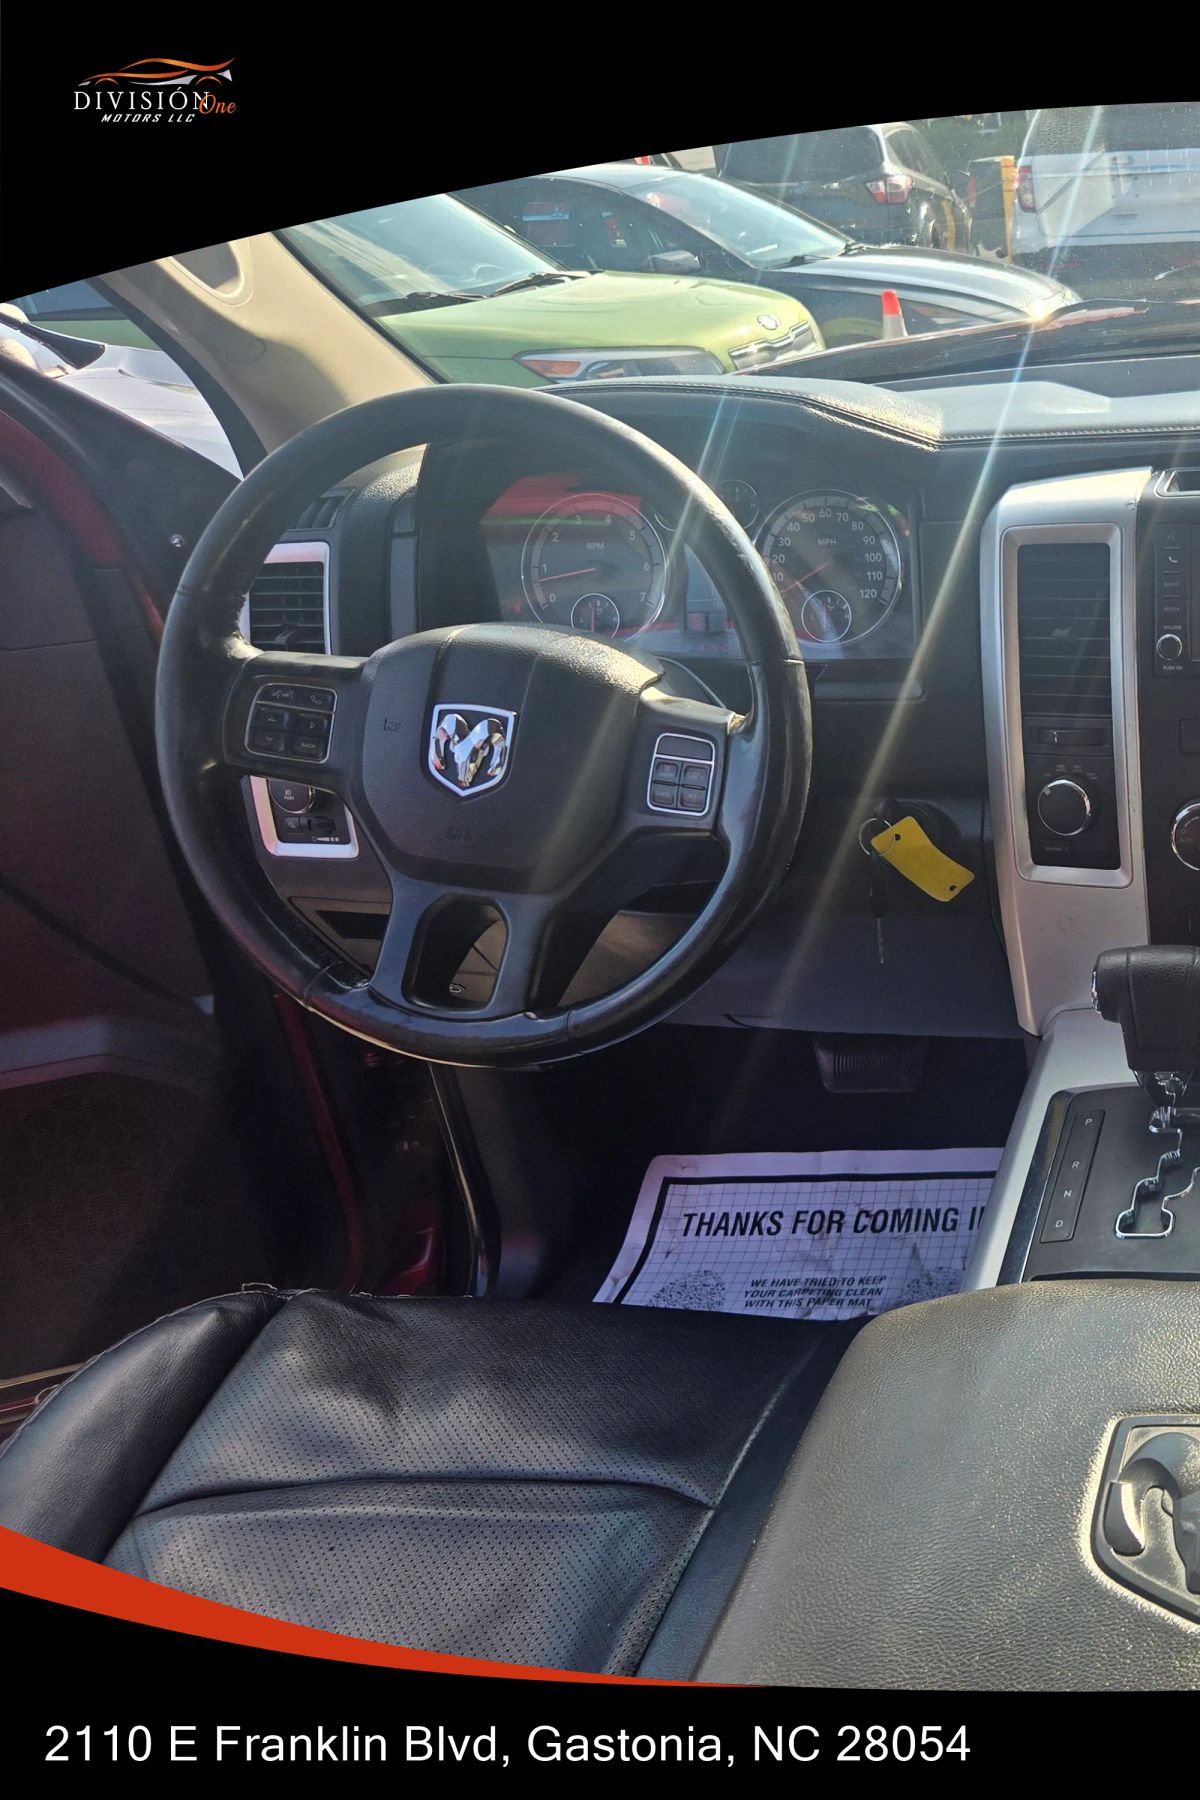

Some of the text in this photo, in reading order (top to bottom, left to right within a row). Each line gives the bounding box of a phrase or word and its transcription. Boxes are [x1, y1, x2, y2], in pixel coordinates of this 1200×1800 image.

[802, 513, 815, 523] 50
[818, 508, 832, 518] 60
[837, 512, 849, 522] 70
[575, 515, 582, 525] 3
[605, 514, 612, 524] 4
[787, 522, 800, 532] 40
[852, 521, 864, 531] 80
[552, 533, 559, 542] 2
[629, 531, 636, 541] 5
[863, 535, 876, 545] 90
[587, 542, 605, 550] RPM
[778, 537, 791, 547] 30
[818, 538, 837, 546] MPH
[772, 554, 785, 564] 20
[865, 553, 882, 563] 100
[542, 563, 547, 573] 1
[643, 561, 650, 571] 6
[773, 572, 784, 582] 10
[867, 571, 883, 581] 110
[549, 593, 556, 603] 0
[639, 592, 646, 601] 7
[860, 588, 877, 599] 120
[1084, 1117, 1093, 1126] P
[1071, 1160, 1080, 1169] R
[1063, 1190, 1072, 1198] N
[682, 1210, 784, 1237] THANKS
[791, 1209, 846, 1236] FOR
[853, 1206, 960, 1234] COMING
[1055, 1219, 1064, 1228] D
[751, 1274, 887, 1288] WE HAVE TRIED TO KEEP
[744, 1286, 884, 1298] YOUR CARPETING CLEAN
[745, 1297, 872, 1309] WITH THIS PAPER MAT
